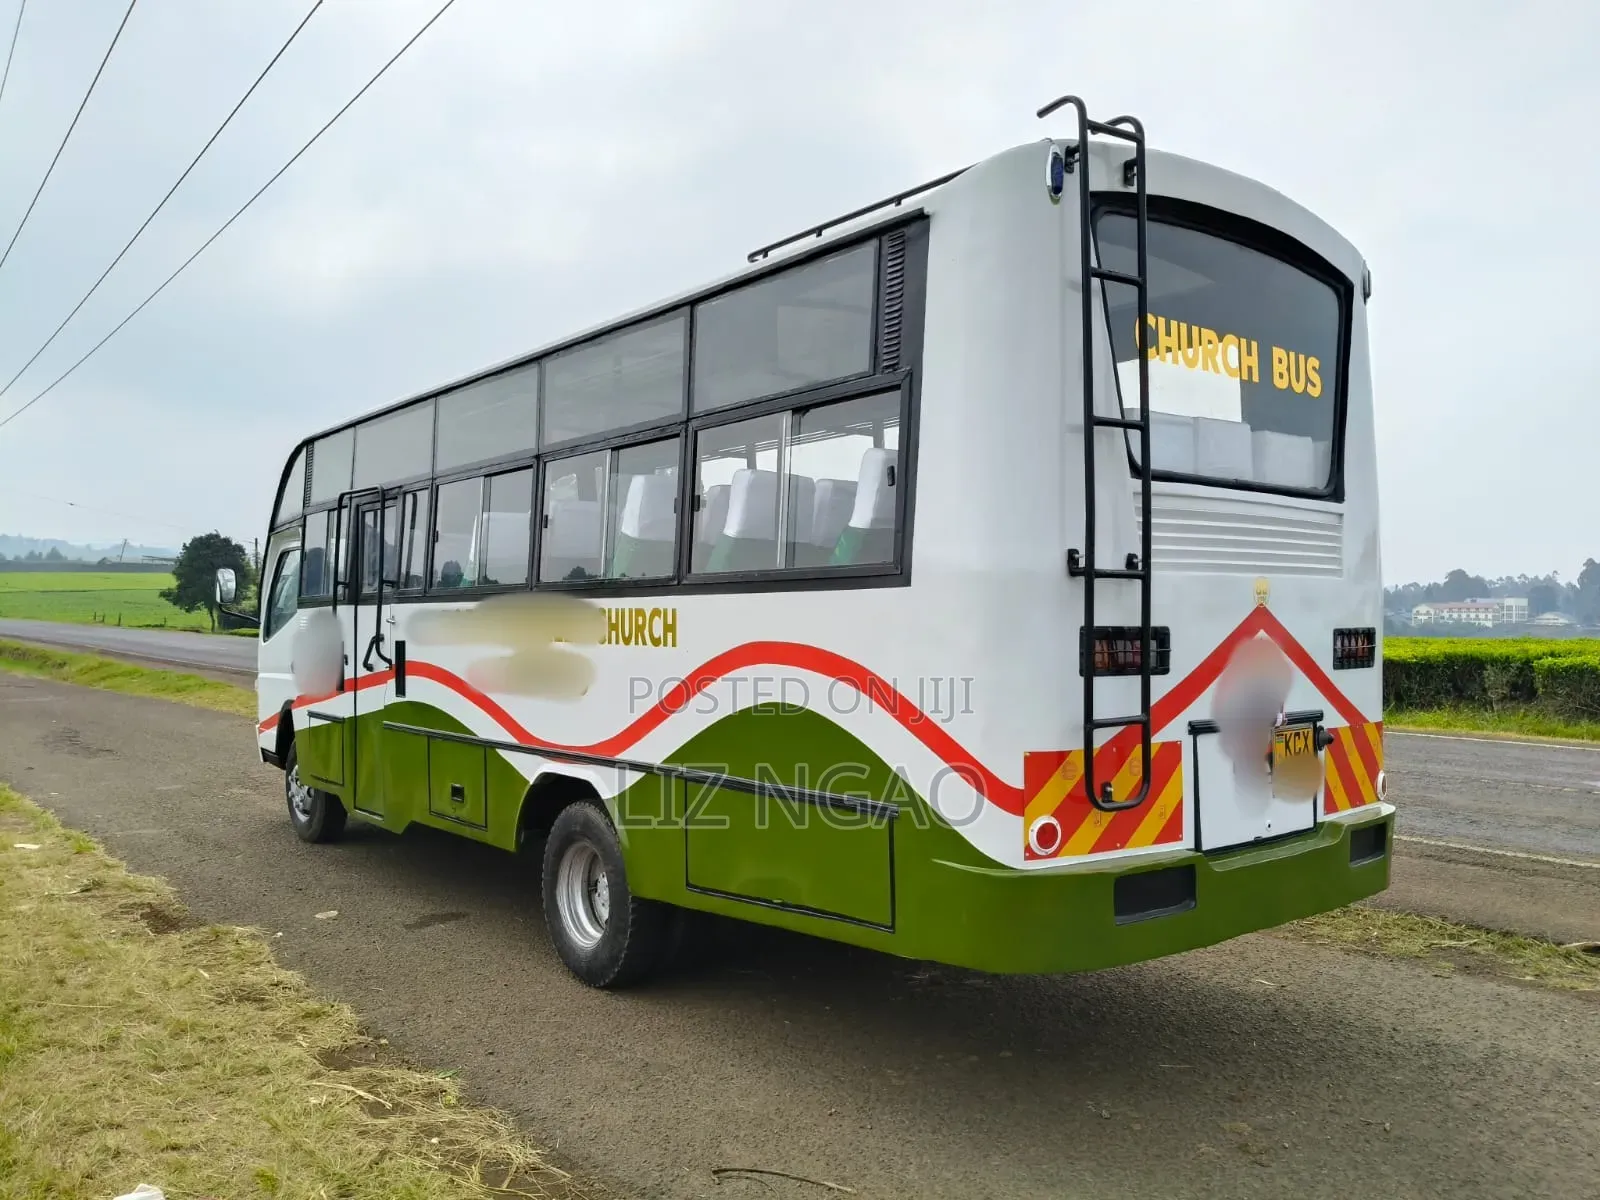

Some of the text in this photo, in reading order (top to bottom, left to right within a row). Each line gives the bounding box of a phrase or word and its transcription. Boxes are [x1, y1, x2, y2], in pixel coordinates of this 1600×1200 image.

[1135, 313, 1322, 397] CHURCH BUS
[1284, 730, 1311, 757] KCX
